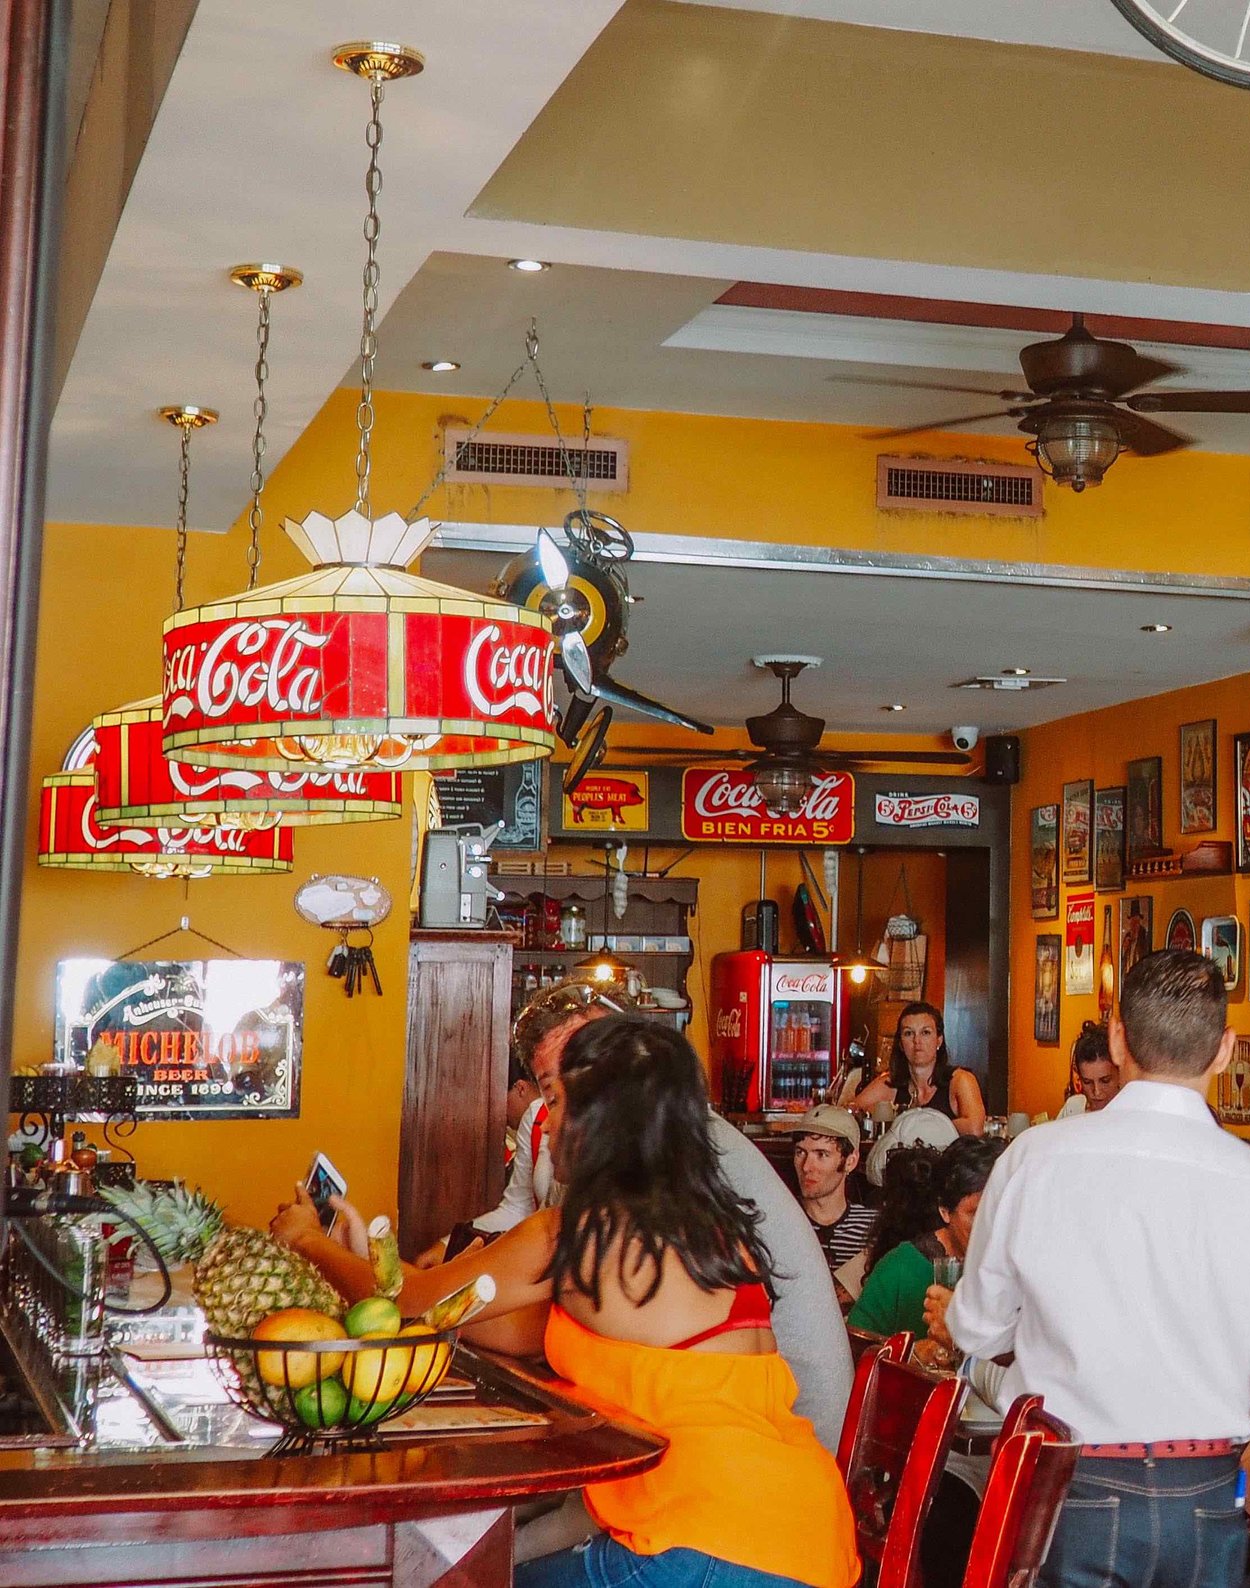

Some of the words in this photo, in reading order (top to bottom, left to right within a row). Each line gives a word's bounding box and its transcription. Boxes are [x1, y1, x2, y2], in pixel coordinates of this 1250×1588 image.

[163, 620, 329, 729] oca-Cola
[465, 624, 554, 724] Coca-C
[694, 772, 845, 820] Cocala
[702, 821, 751, 835] BIEN
[760, 822, 807, 837] FRIA
[812, 821, 835, 839] 5¢
[776, 973, 828, 993] Coca-Cola
[123, 995, 204, 1025] Anheuser-Bu
[716, 1008, 742, 1039] Coca-Cola
[100, 1030, 260, 1066] MICHELOB
[127, 1084, 184, 1097] INCE
[153, 1069, 210, 1082] BEER
